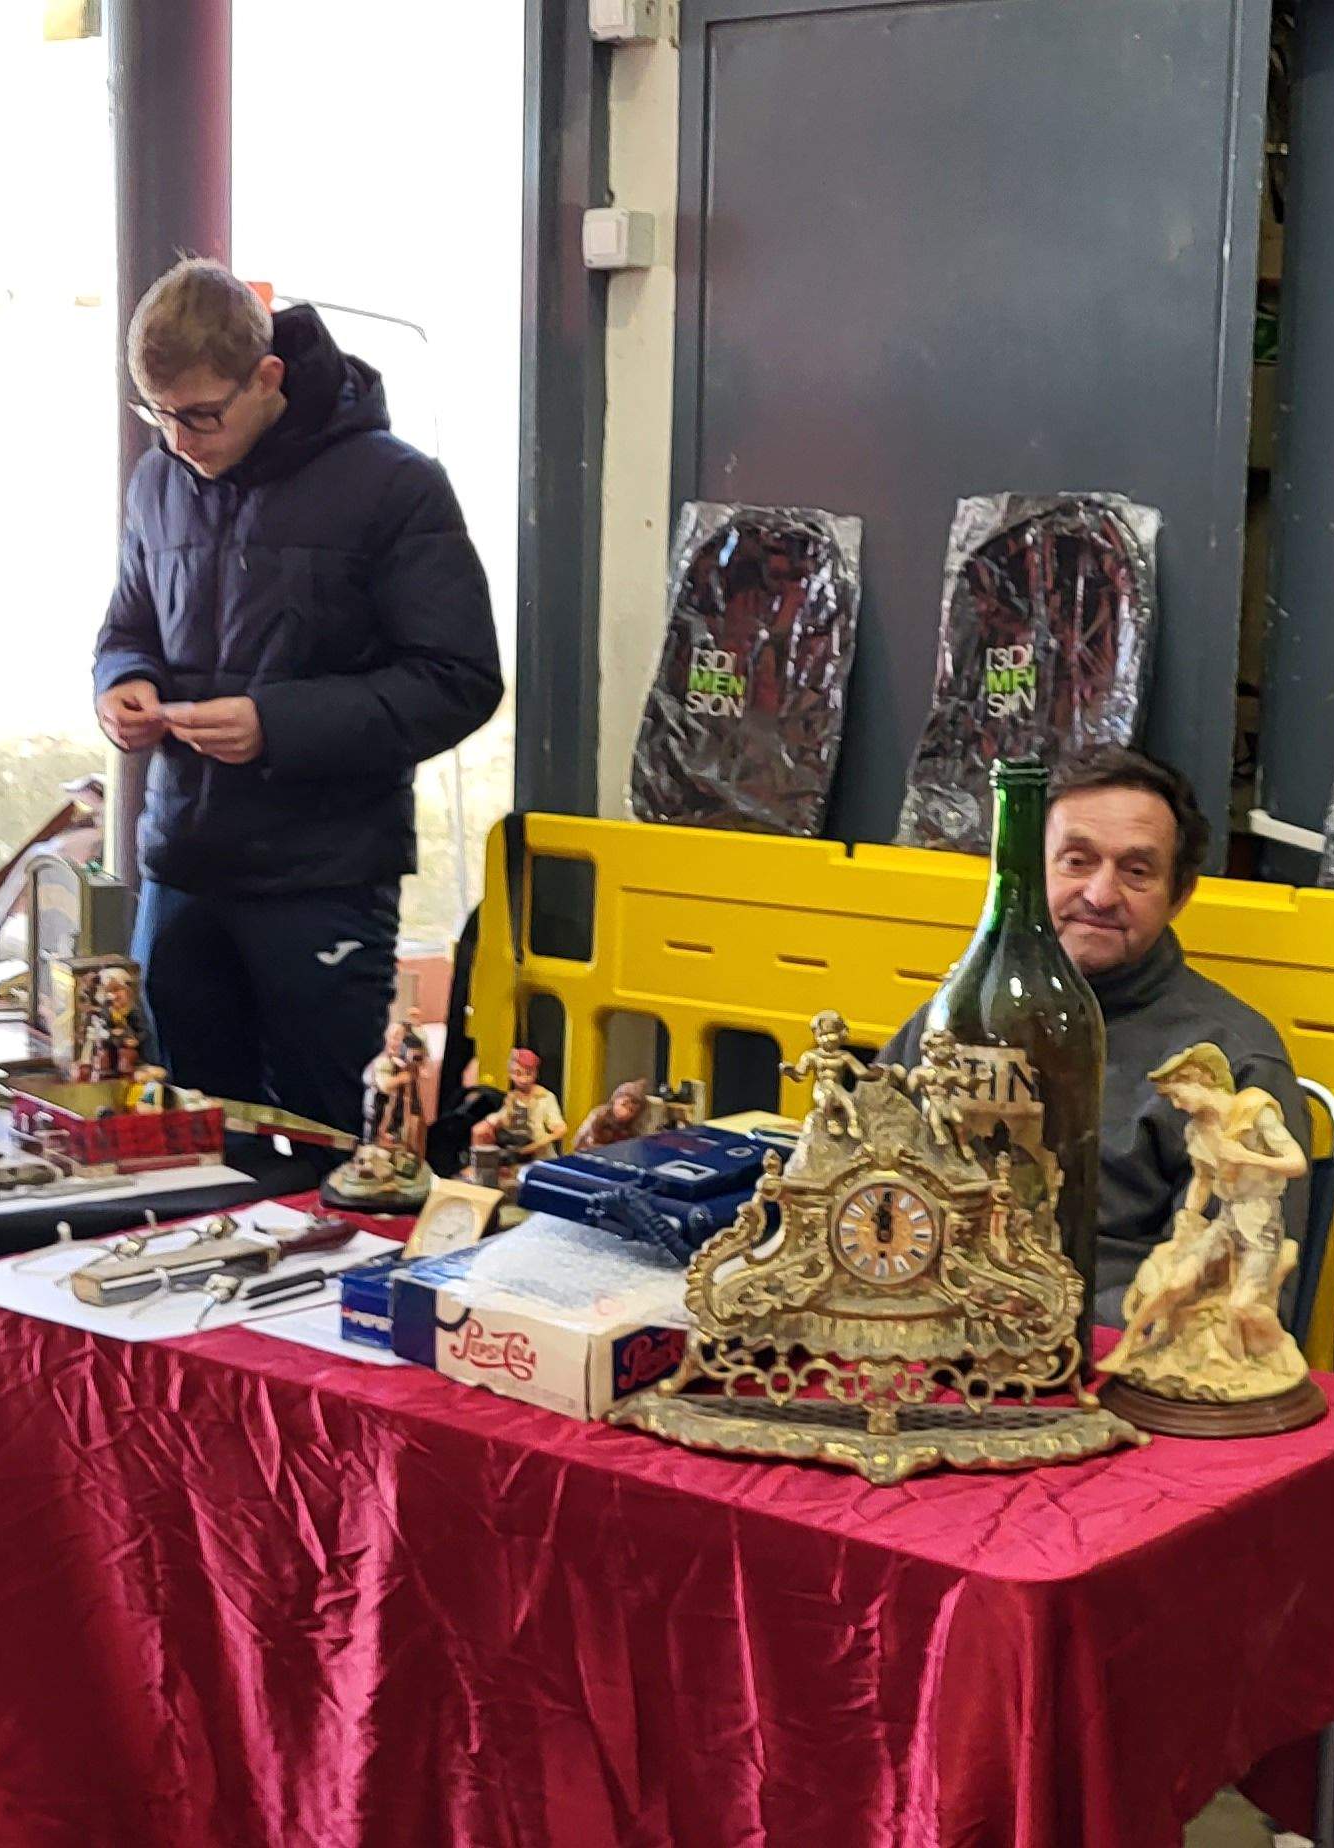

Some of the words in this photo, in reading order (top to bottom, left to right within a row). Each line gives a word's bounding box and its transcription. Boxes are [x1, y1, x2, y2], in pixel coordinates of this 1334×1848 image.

[688, 668, 746, 696] MEN
[685, 691, 744, 718] SION
[953, 1057, 1043, 1103] TIN
